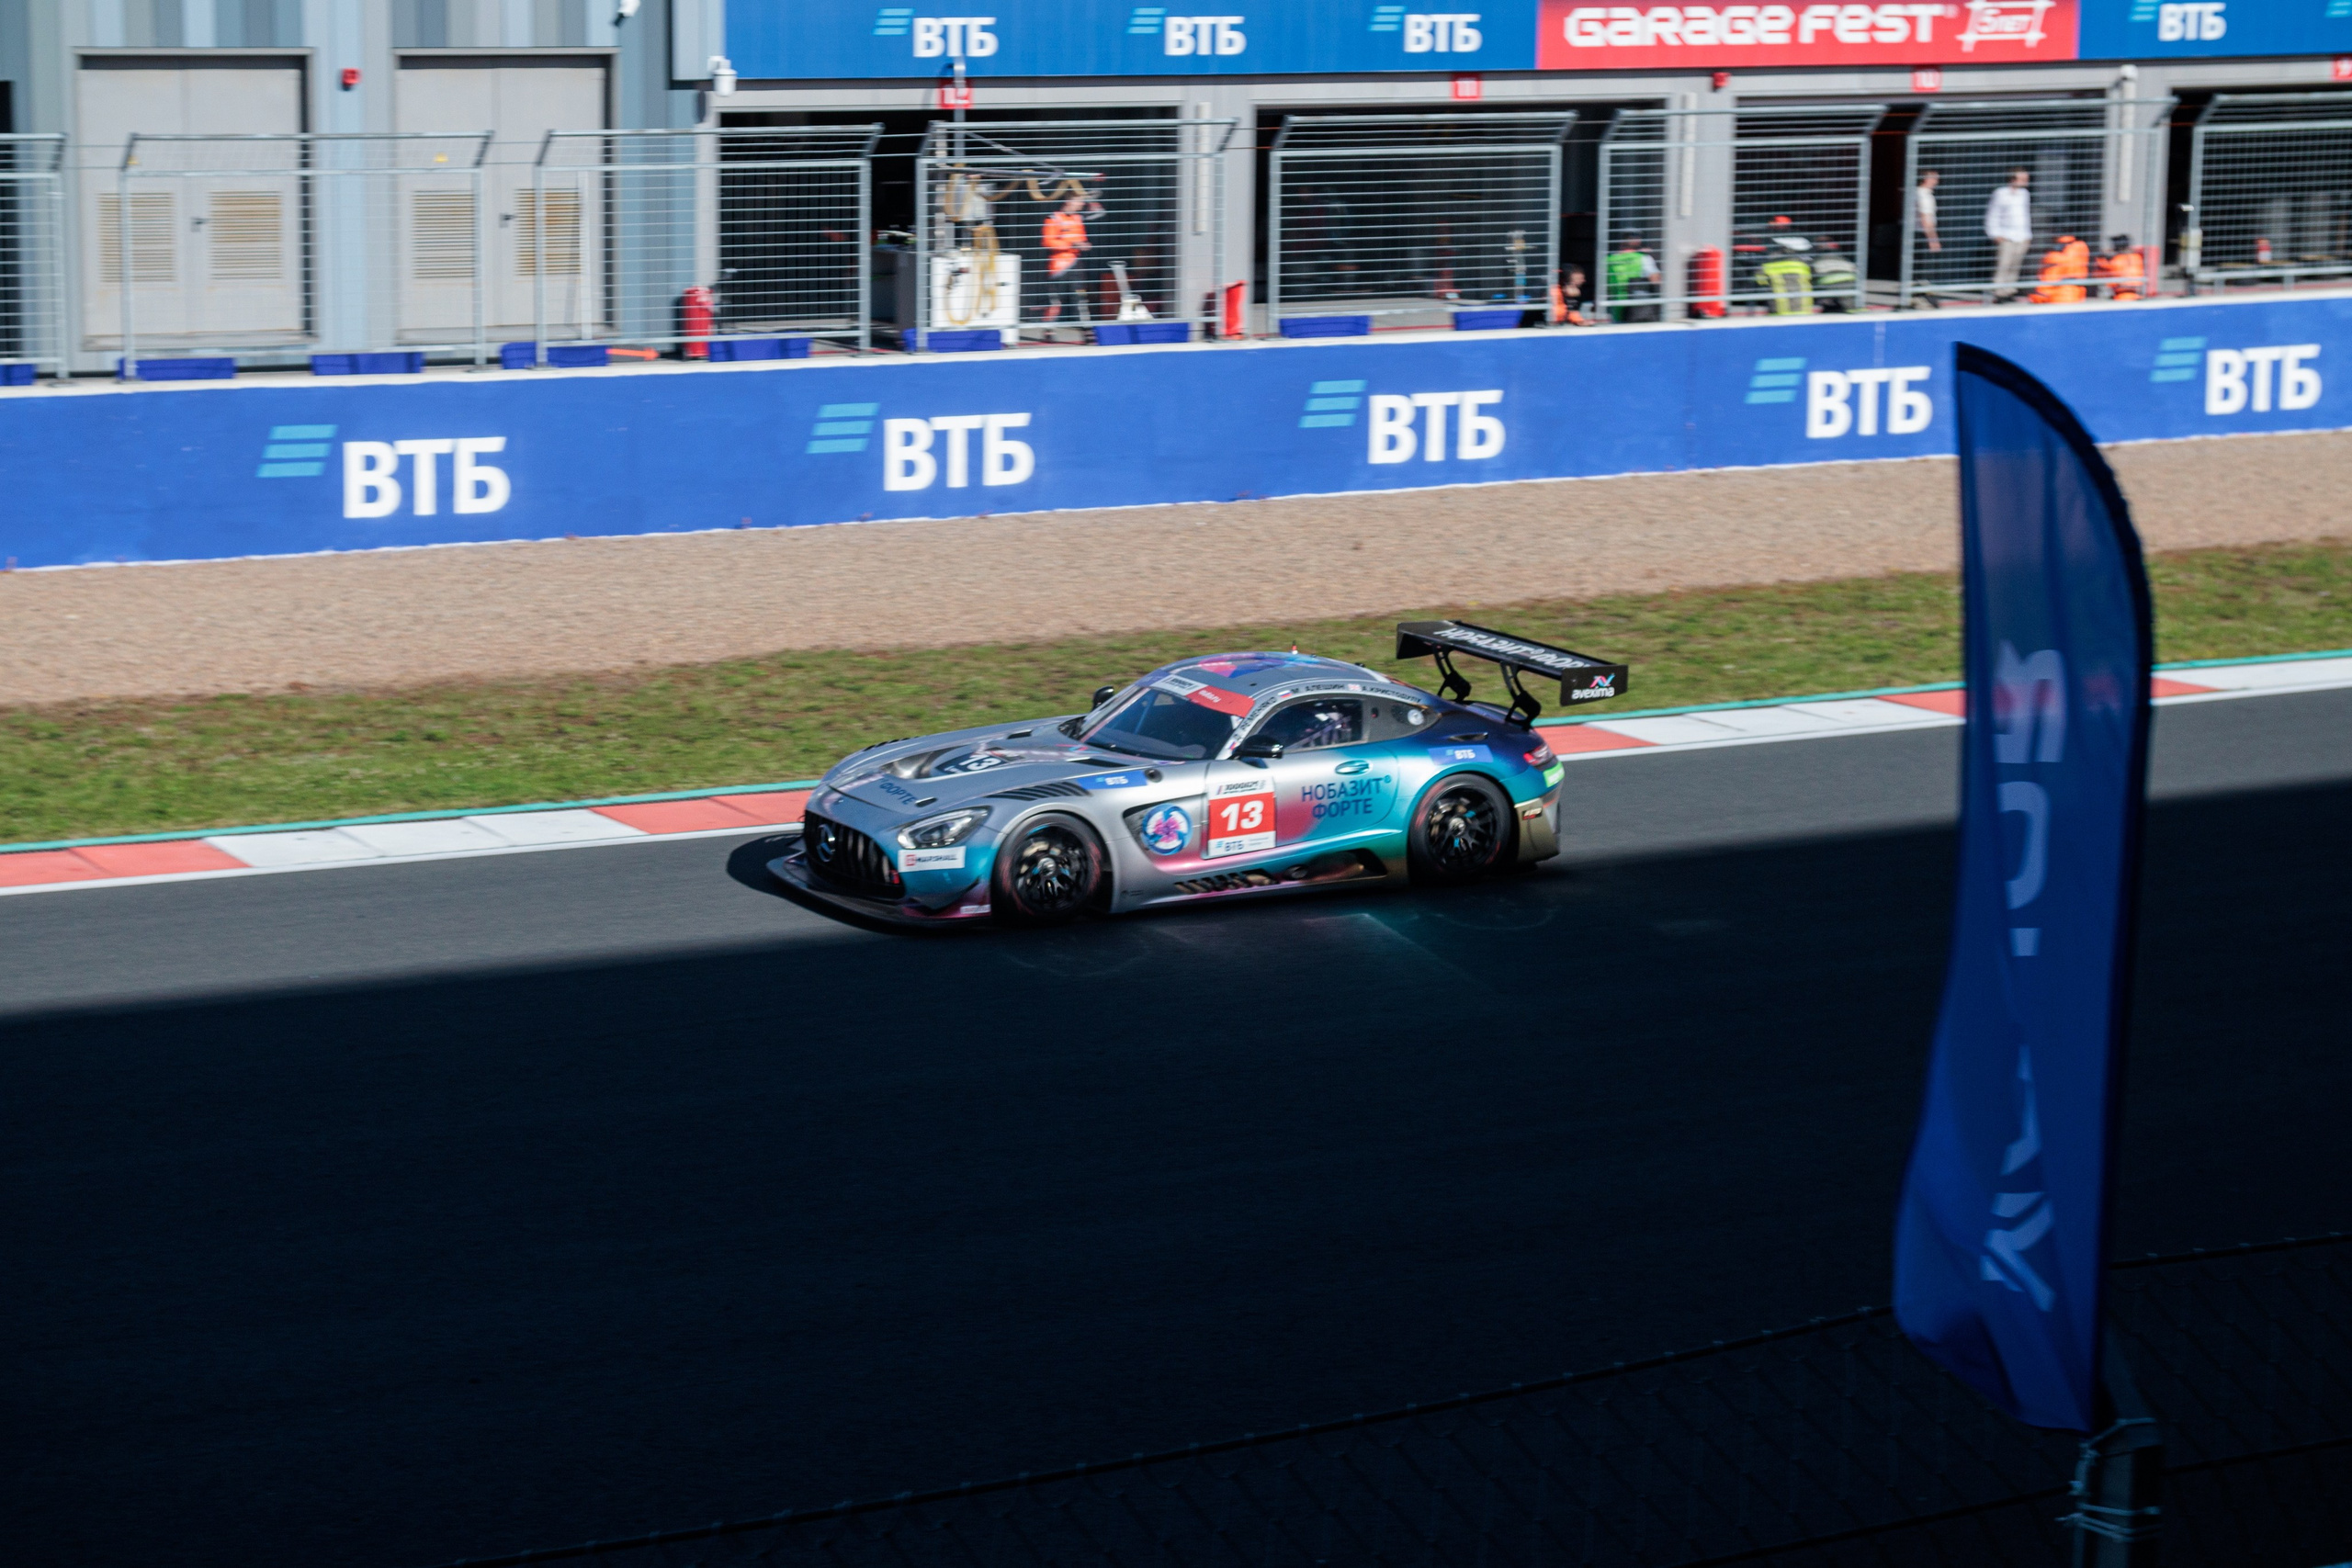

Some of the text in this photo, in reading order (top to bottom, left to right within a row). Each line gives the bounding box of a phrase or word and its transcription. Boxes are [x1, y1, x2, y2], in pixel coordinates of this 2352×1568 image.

[913, 17, 999, 58] ВТБ
[1164, 16, 1247, 55] ВТБ
[1404, 14, 1483, 52] ВТБ
[2157, 2, 2227, 41] ВТБ
[2205, 344, 2323, 415] ВТБ
[1806, 366, 1934, 438] ВТБ
[1367, 390, 1506, 464] ВТБ
[883, 412, 1035, 491] ВТБ
[343, 436, 512, 519] ВТБ
[1571, 685, 1615, 700] avexima
[959, 754, 1001, 771] 13
[1454, 749, 1476, 760] ВТБ
[879, 782, 917, 805] ФОРТЕ
[1312, 797, 1374, 819] ФОРТЕ
[1220, 800, 1264, 831] 13
